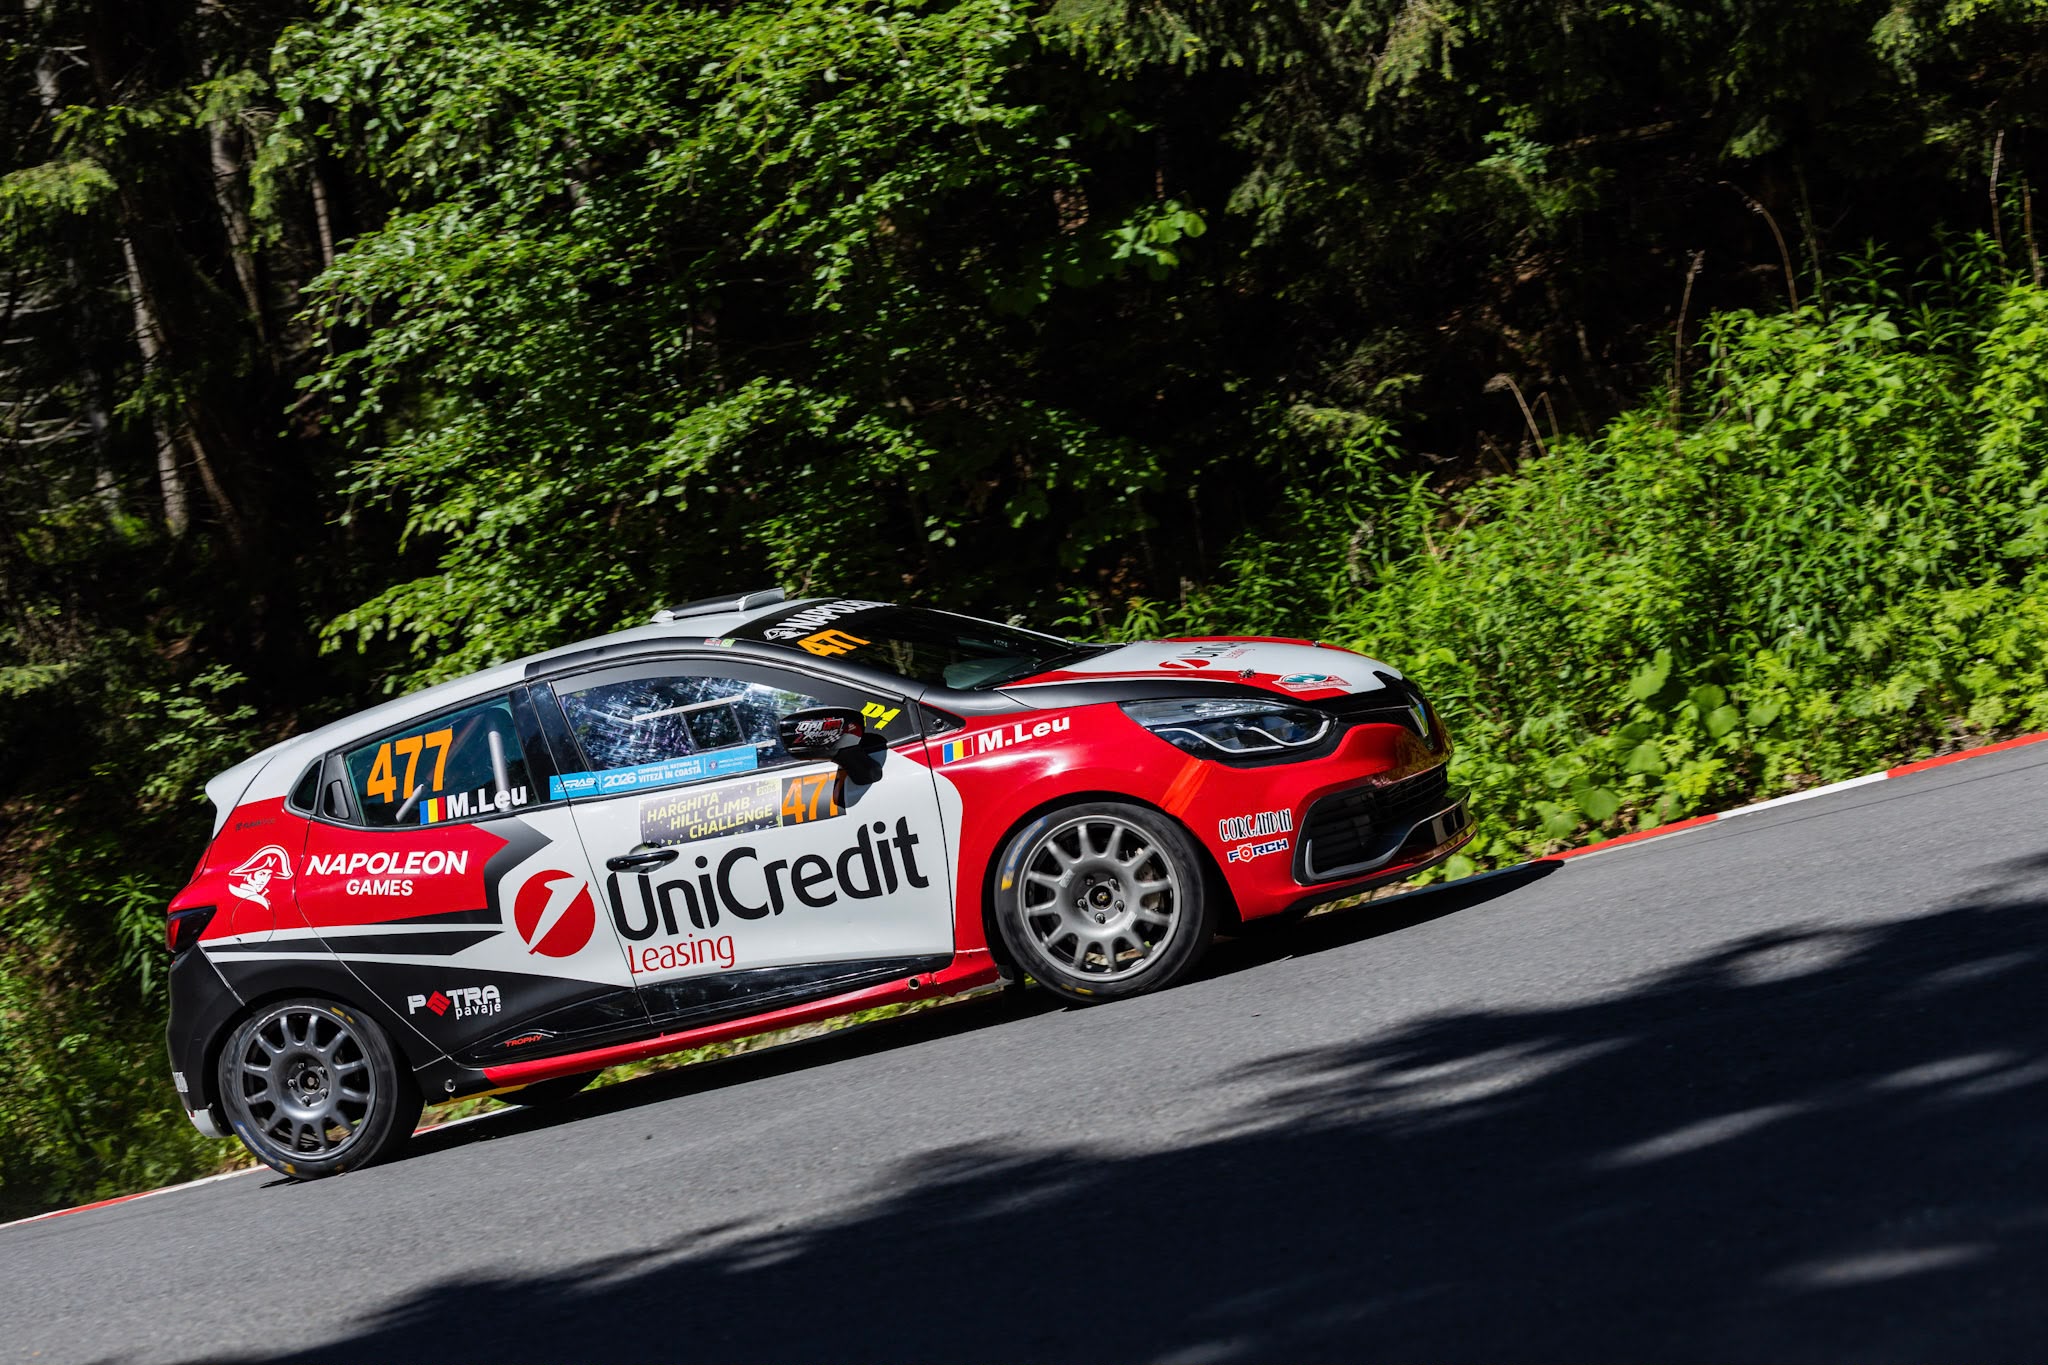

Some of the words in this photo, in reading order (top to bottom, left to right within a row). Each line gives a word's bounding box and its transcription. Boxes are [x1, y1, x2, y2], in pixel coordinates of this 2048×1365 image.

[797, 629, 871, 656] 477
[978, 716, 1070, 754] M.Leu
[367, 727, 452, 802] 477
[603, 771, 637, 788] 2026
[447, 786, 527, 818] M.Leu
[647, 792, 720, 823] HARGHITA
[671, 814, 703, 830] HILL
[706, 796, 750, 821] CLIMB
[689, 803, 773, 839] CHALLENGE
[306, 850, 468, 876] NAPOLEON
[606, 816, 930, 941] UniCredit
[346, 880, 413, 897] GAMES
[628, 932, 736, 975] Leasing
[455, 1000, 502, 1020] pavaje
[504, 1034, 544, 1048] TROPHY
